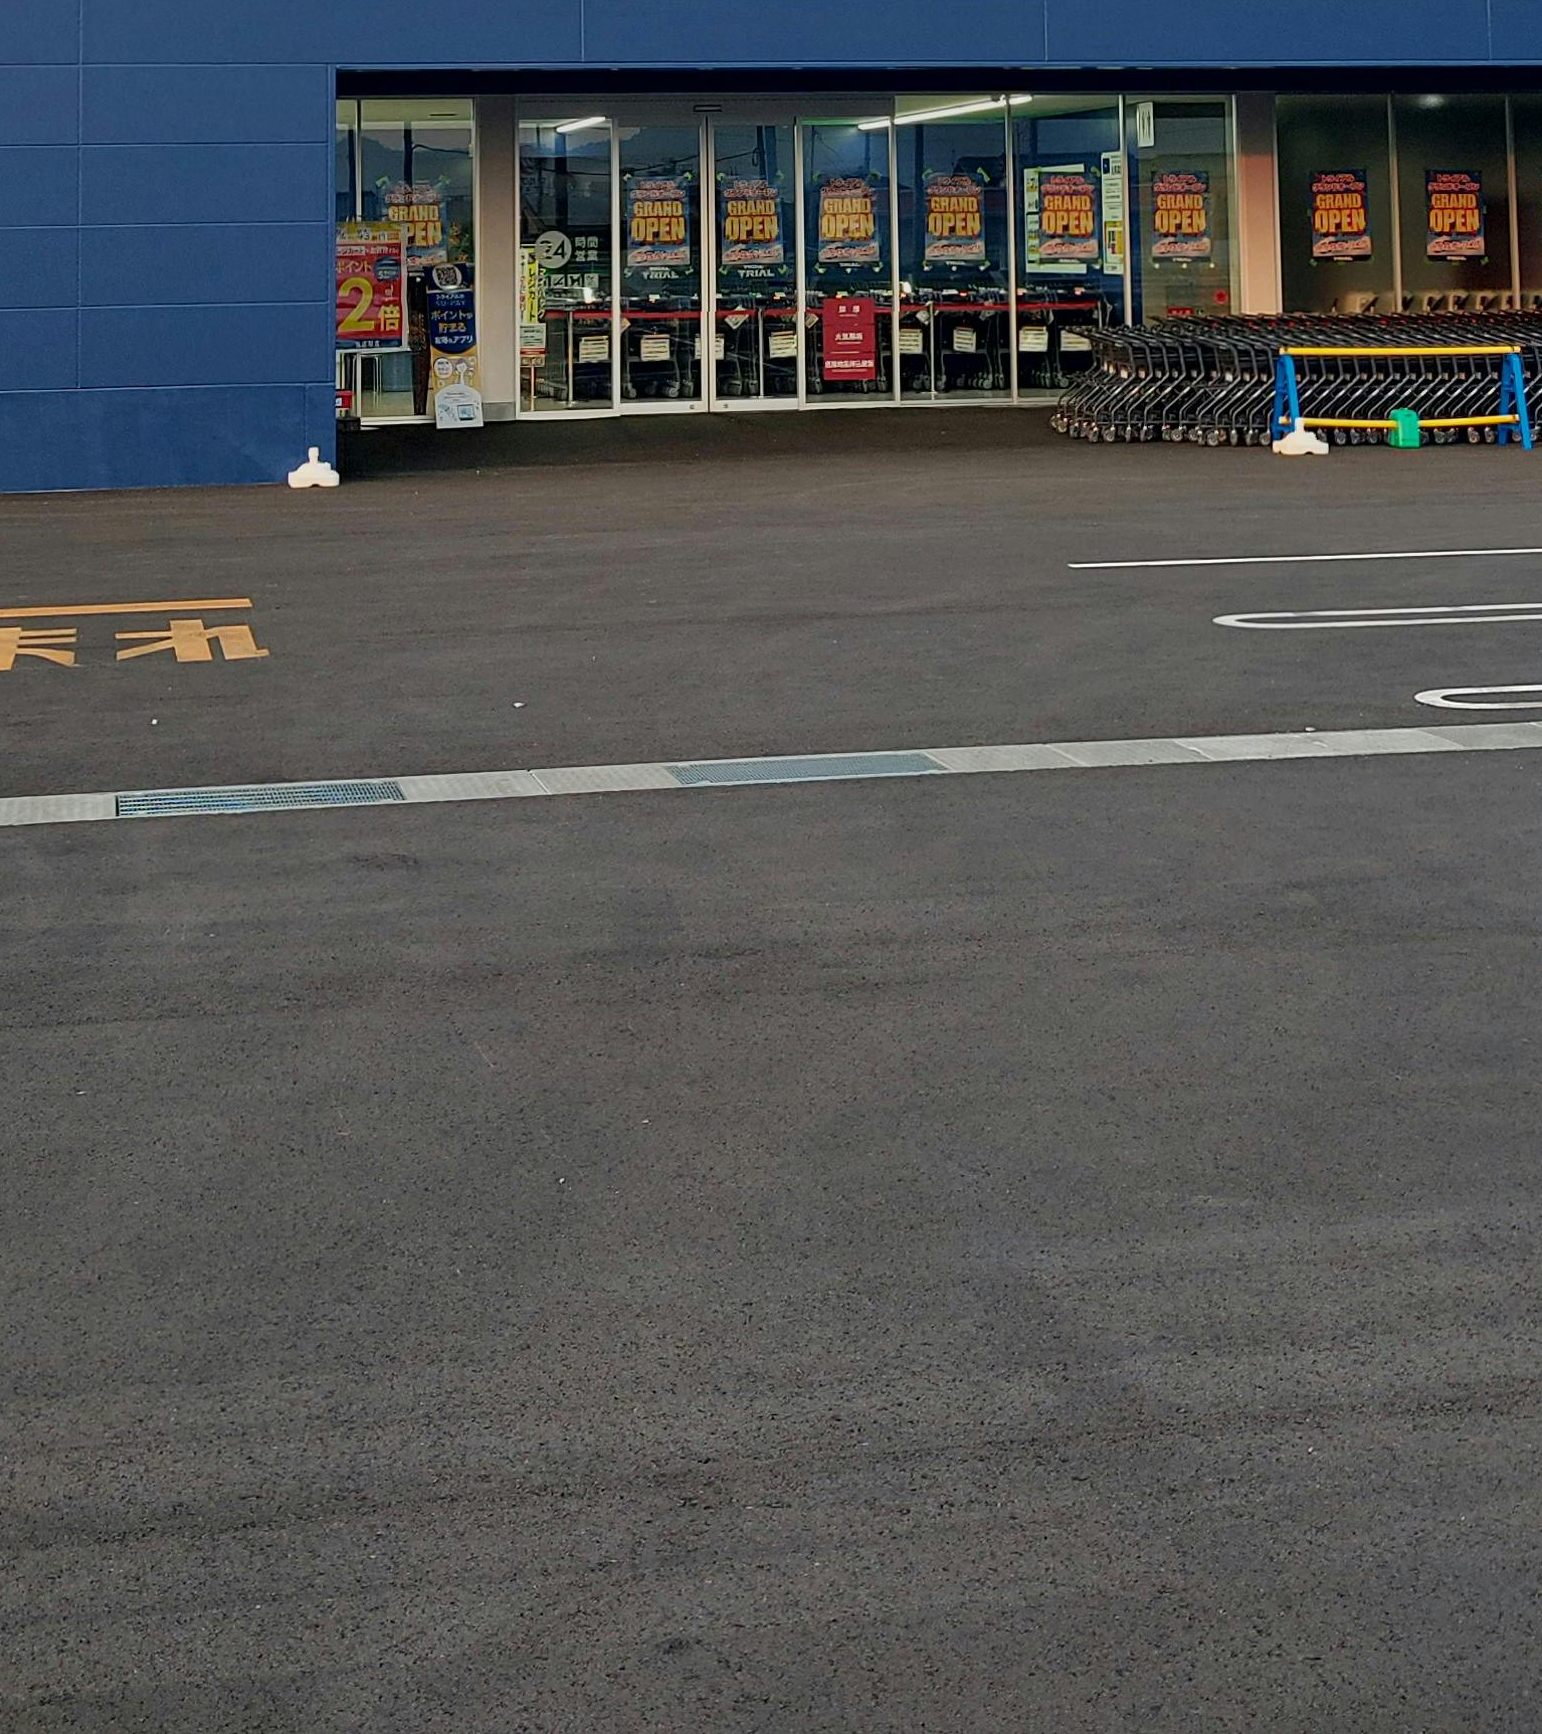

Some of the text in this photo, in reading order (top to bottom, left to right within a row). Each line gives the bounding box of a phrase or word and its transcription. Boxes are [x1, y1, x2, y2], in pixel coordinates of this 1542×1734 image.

[632, 201, 683, 216] GRAND
[727, 200, 776, 215] GRAND
[824, 198, 871, 213] GRAND
[931, 196, 978, 211] GRAND
[1045, 195, 1091, 210] GRAND
[1157, 194, 1203, 209] GRAND
[1316, 193, 1362, 208] GRAND
[1431, 193, 1477, 208] GRAND
[388, 205, 439, 221] GRAND
[1315, 208, 1366, 233] OPEN
[1430, 208, 1479, 232] OPEN
[631, 217, 686, 241] OPEN
[725, 216, 779, 240] OPEN
[822, 213, 874, 238] OPEN
[929, 212, 980, 235] OPEN
[1042, 211, 1093, 234] OPEN
[1155, 210, 1206, 233] OPEN
[406, 222, 442, 246] PEN
[539, 239, 566, 260] 24
[574, 236, 599, 249] 時間
[737, 269, 775, 278] TRIAL
